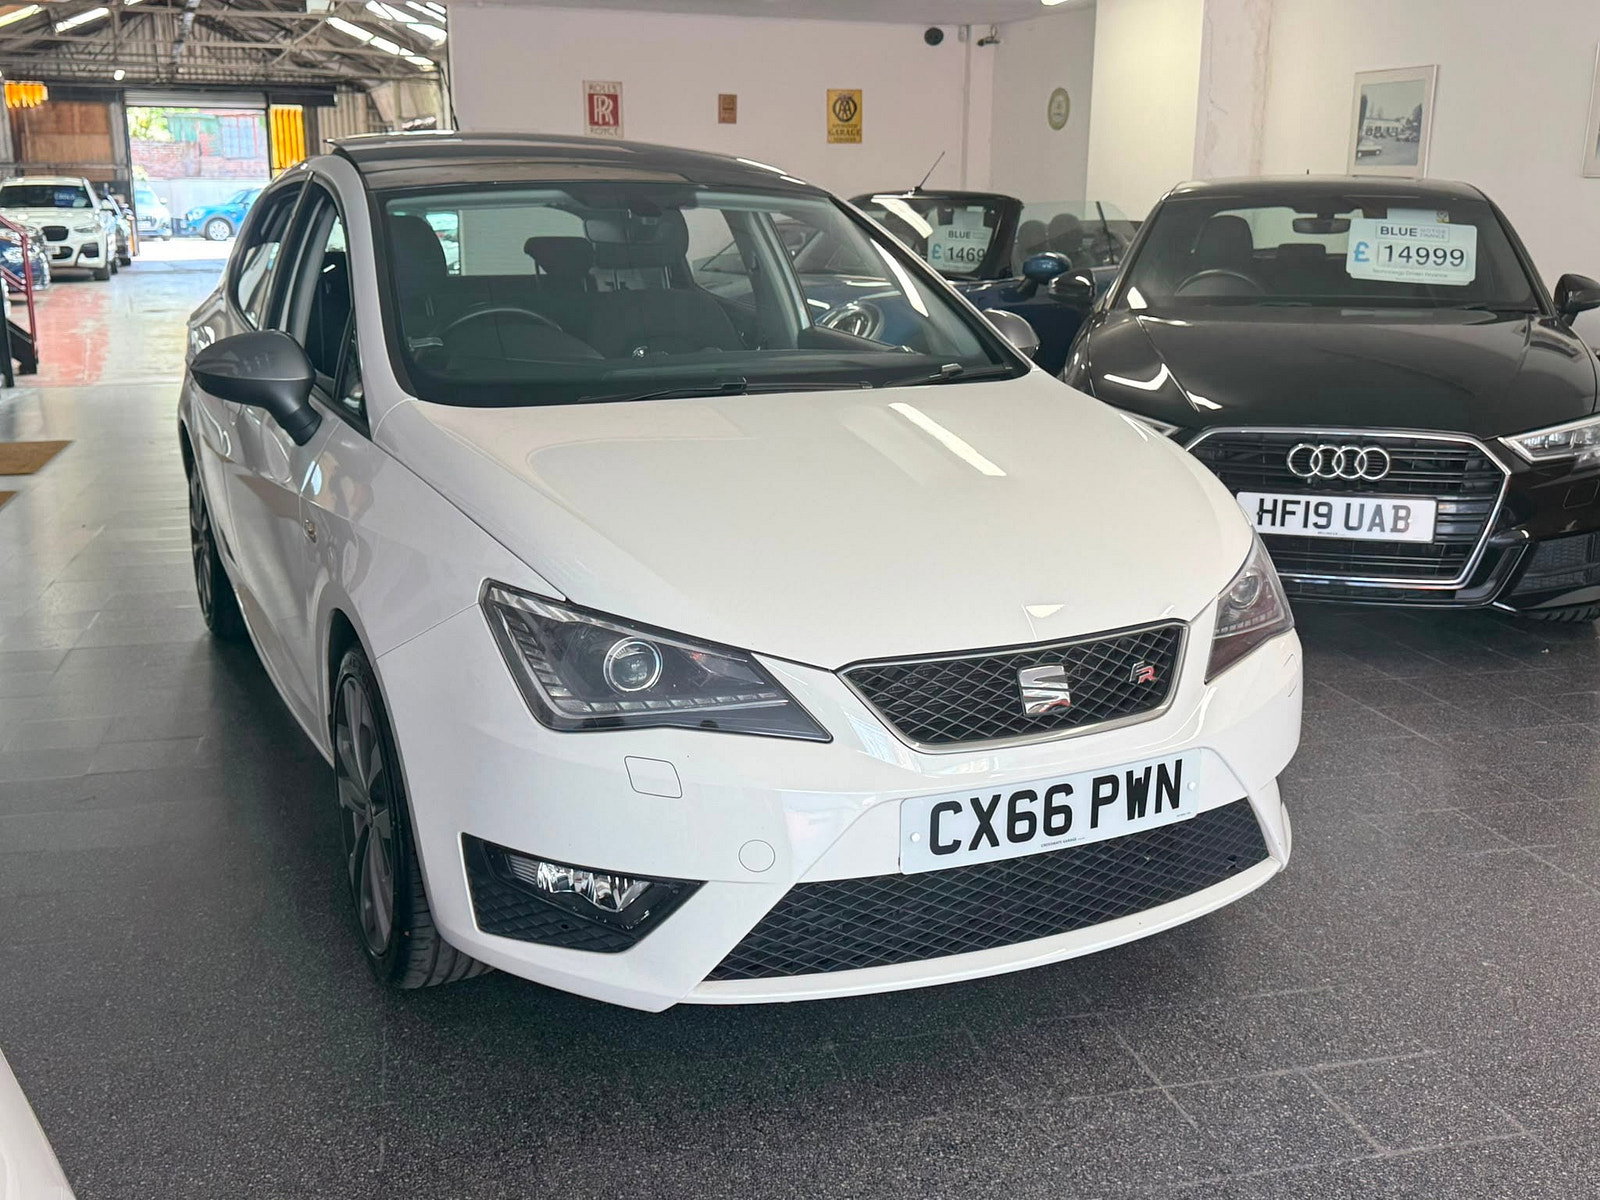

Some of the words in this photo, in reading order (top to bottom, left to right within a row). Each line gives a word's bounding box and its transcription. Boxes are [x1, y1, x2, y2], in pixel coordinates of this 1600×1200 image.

[948, 230, 972, 239] BLUE
[1380, 226, 1418, 237] BLUE
[1353, 241, 1370, 263] £
[1383, 244, 1465, 268] 14999
[1257, 498, 1333, 529] HF19
[1343, 502, 1412, 534] UAB
[929, 782, 1075, 856] CX66
[1090, 758, 1184, 830] PWN
